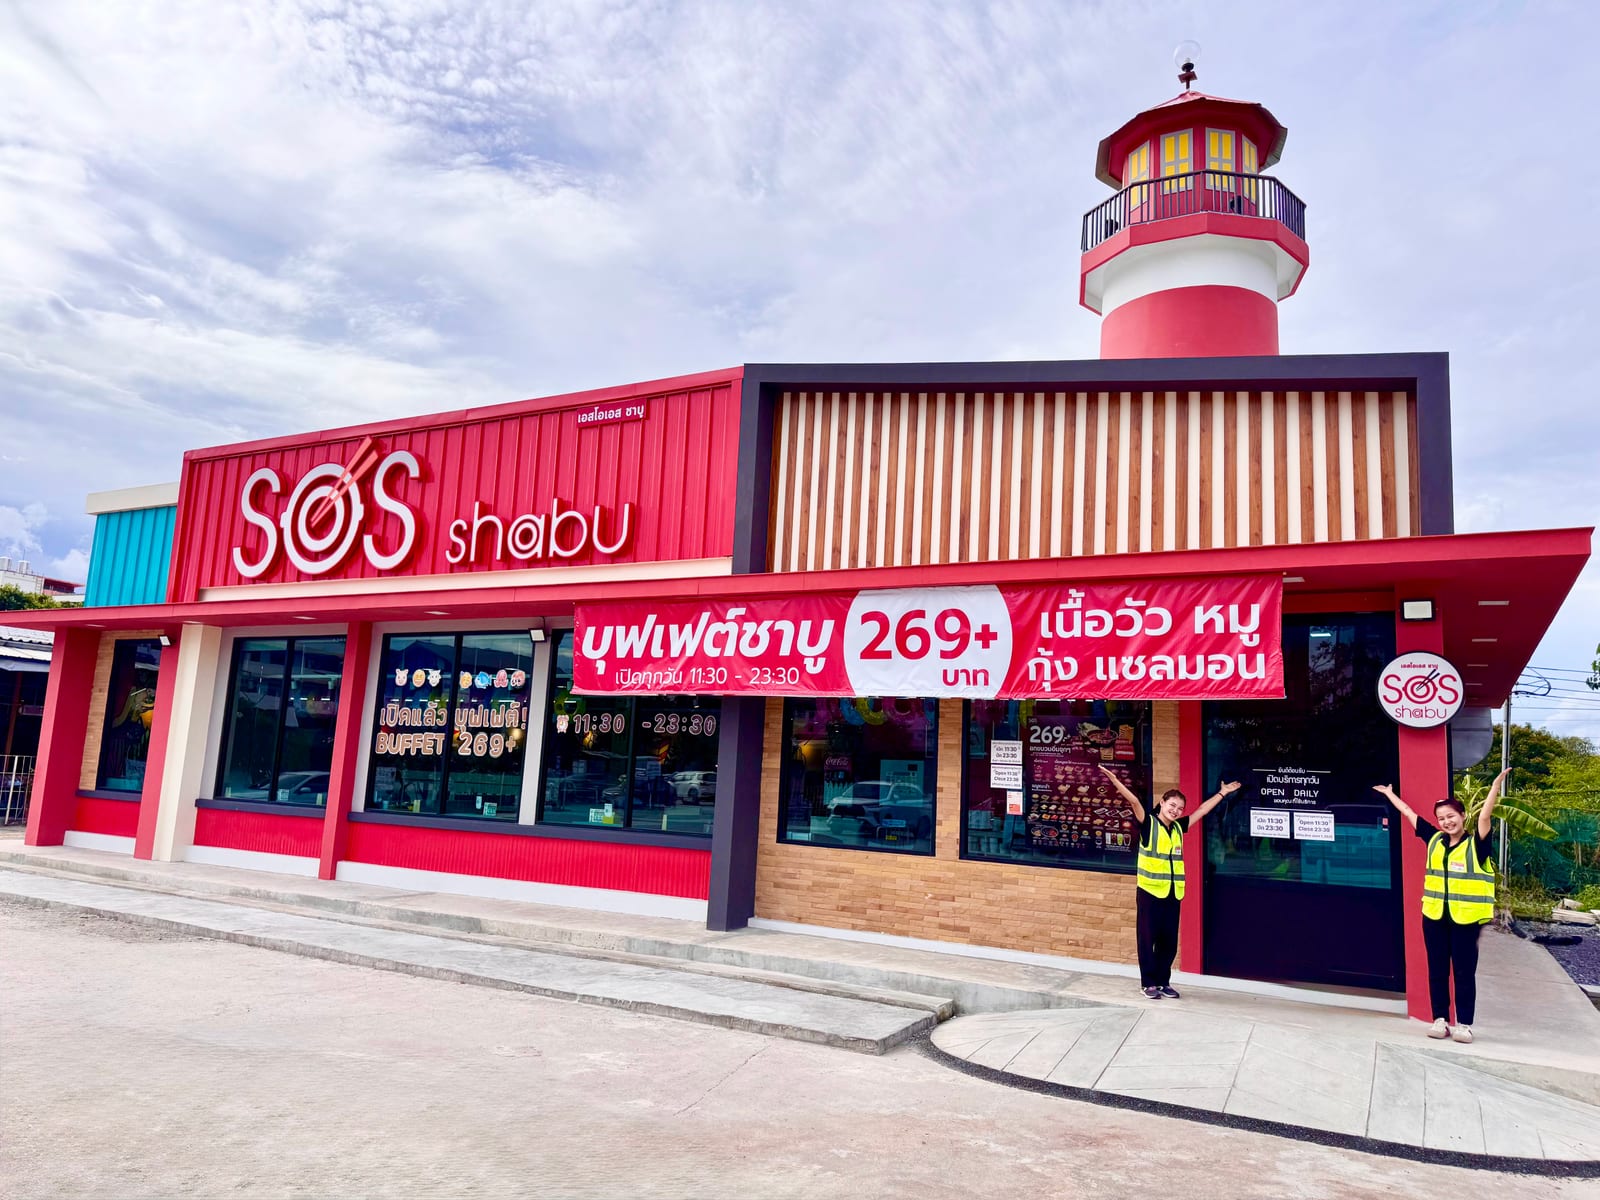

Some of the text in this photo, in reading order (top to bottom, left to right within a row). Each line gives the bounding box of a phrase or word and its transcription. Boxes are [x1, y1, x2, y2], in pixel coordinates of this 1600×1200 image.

[578, 405, 645, 423] เอสโอเอส ชาบู
[233, 450, 420, 578] SOS
[446, 499, 632, 564] shabu
[1040, 589, 1260, 647] เนื้อวัว หมู
[581, 607, 835, 675] บุฟเฟต์ชาบู
[860, 608, 998, 660] 269+
[615, 667, 683, 689] เปิดทุกวัน
[690, 668, 728, 685] 11:30
[749, 667, 800, 685] 23:30
[942, 668, 989, 686] บาท
[1028, 648, 1266, 692] กุ้ง แซลมอน
[1383, 674, 1459, 705] SOS
[380, 702, 447, 727] เปิดแล้ว
[573, 713, 625, 734] 11:30
[1395, 705, 1447, 719] shabu
[375, 732, 516, 757] BUFFET 269+
[1260, 787, 1319, 798] OPEN DAILY
[1266, 774, 1319, 786] เปิดบริการทุกวัน
